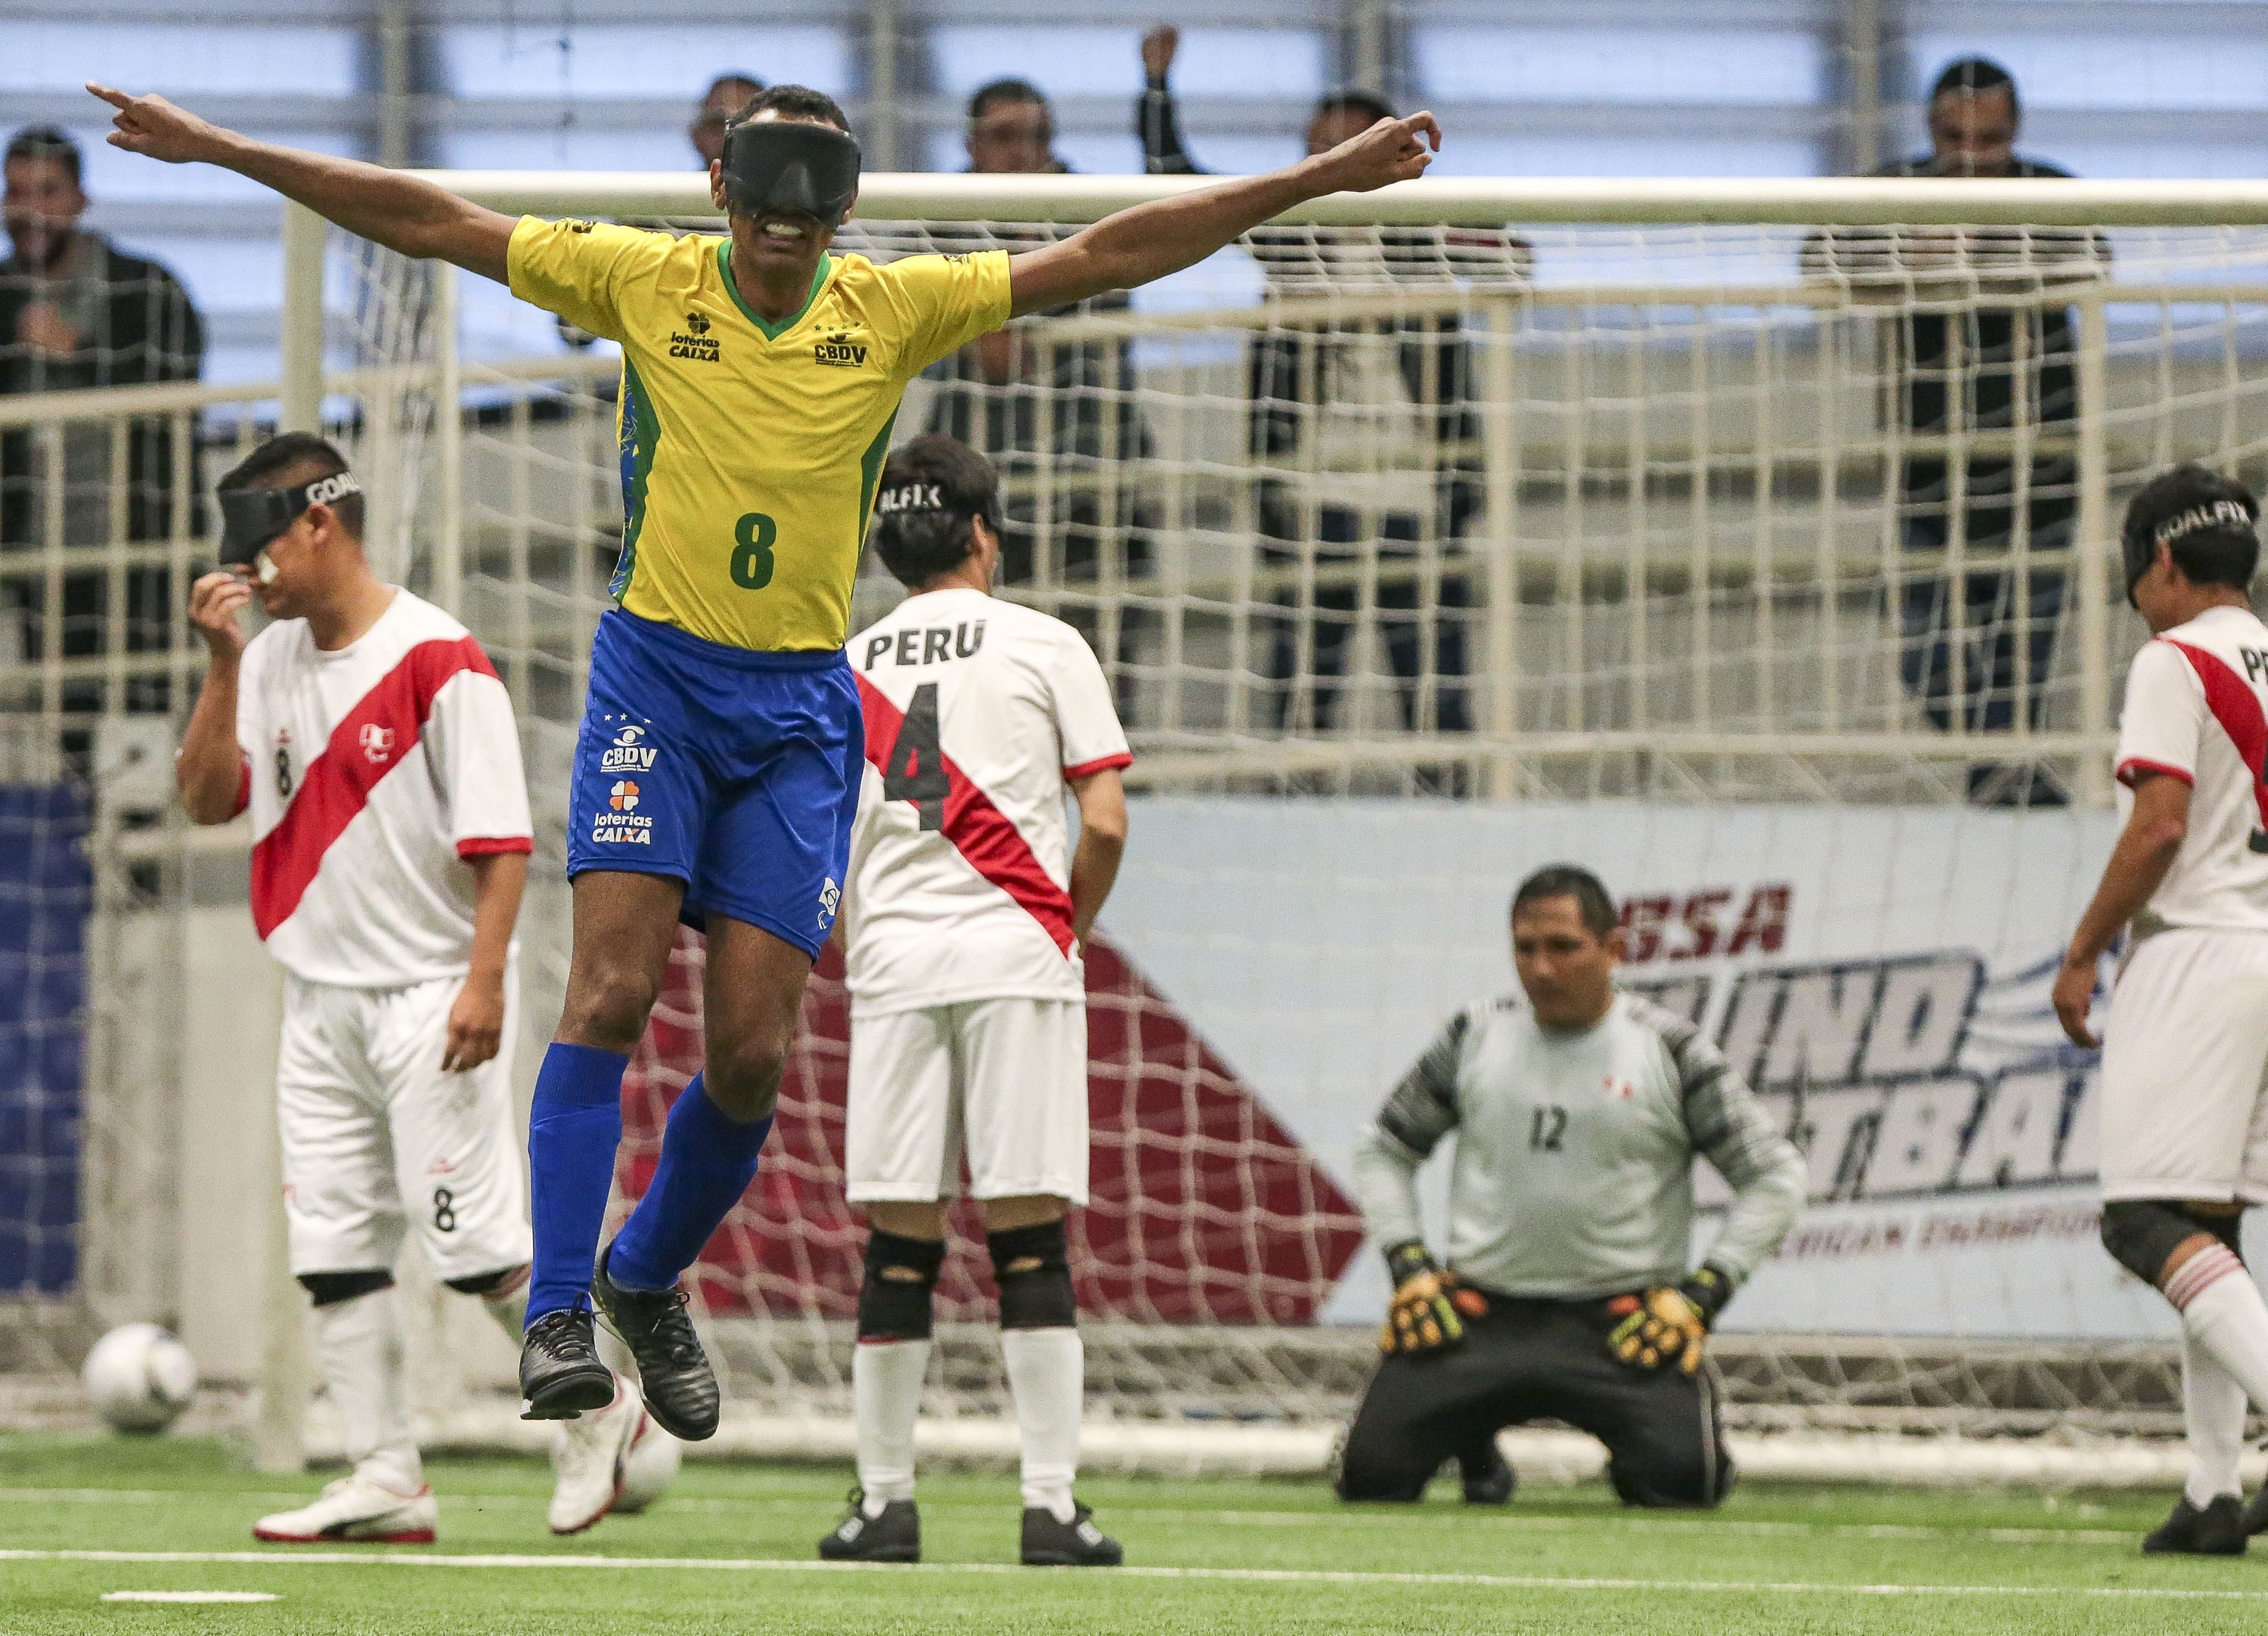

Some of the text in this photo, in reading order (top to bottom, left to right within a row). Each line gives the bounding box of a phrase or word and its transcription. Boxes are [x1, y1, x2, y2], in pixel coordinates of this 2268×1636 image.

[671, 332, 720, 348] loterias
[669, 345, 720, 362] CAIXA
[814, 345, 867, 364] CBDV
[730, 512, 777, 590] 8
[602, 747, 658, 767] CBDV
[884, 681, 950, 831] 4
[275, 747, 293, 797] 8
[594, 812, 652, 827] loterias
[592, 827, 651, 844] CAIXA
[1530, 1106, 1567, 1151] 12
[435, 1188, 455, 1232] 8
